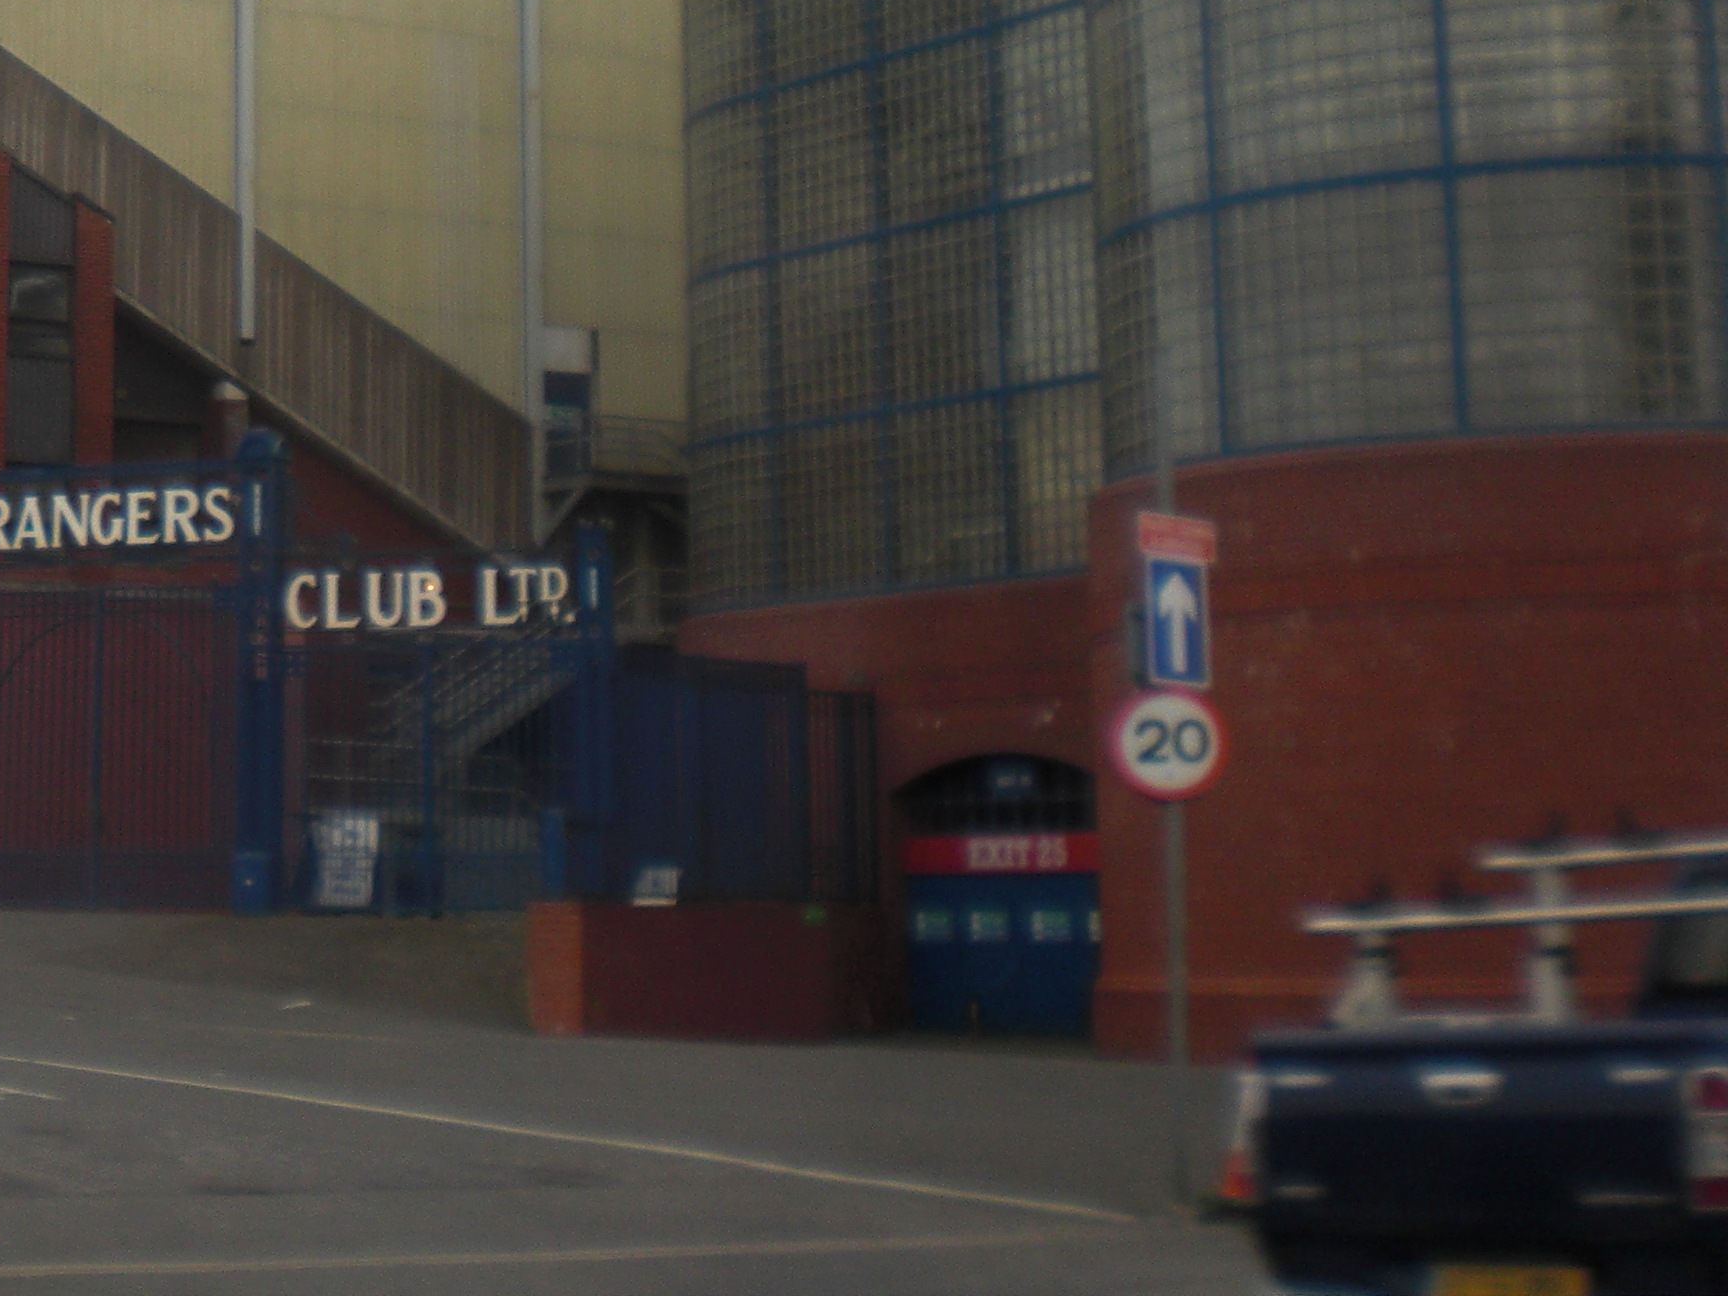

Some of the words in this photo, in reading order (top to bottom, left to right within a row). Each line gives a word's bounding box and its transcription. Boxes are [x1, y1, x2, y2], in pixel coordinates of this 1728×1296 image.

[284, 570, 447, 629] CLUB
[1135, 718, 1210, 765] 20
[969, 836, 1030, 870] EXIT
